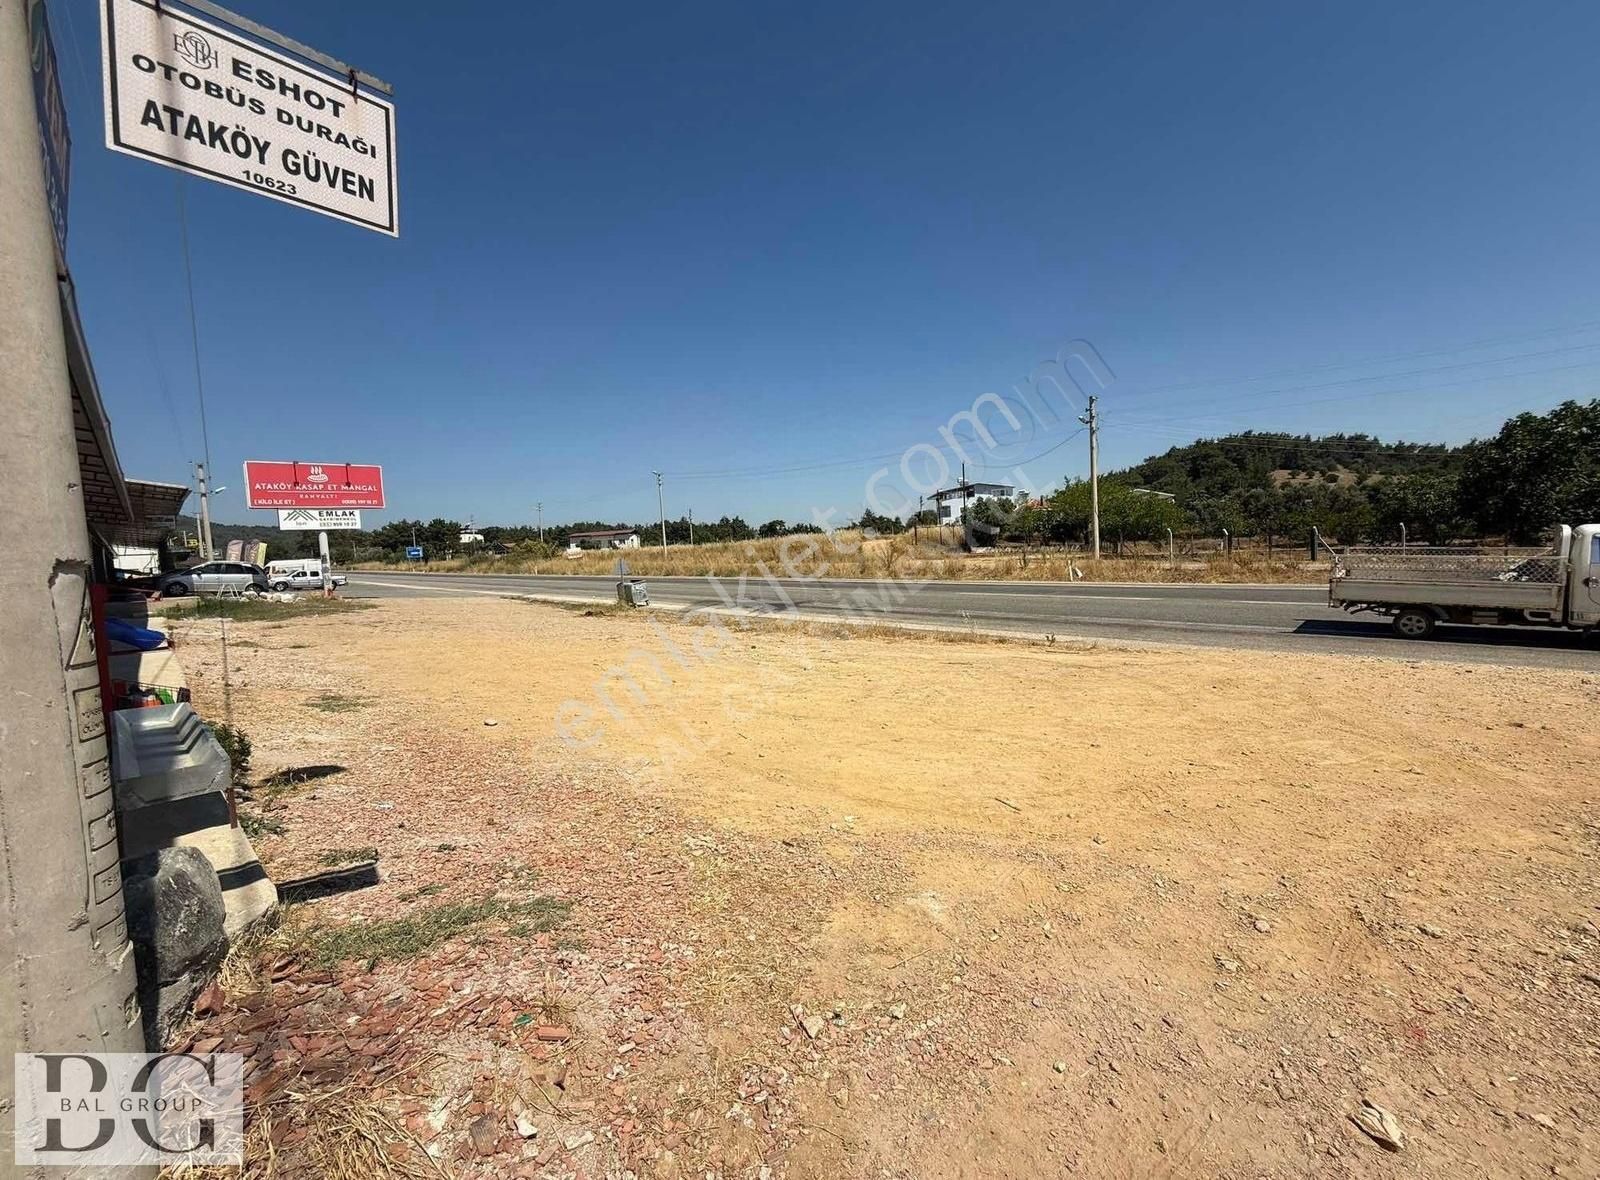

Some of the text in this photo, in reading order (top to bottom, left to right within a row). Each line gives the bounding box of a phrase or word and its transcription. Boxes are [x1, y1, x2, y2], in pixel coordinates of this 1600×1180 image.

[132, 53, 377, 159] OTOBÜS DURAĞI
[232, 57, 345, 118] ESHOT
[140, 99, 375, 202] ATAKÖY GÜVEN
[242, 170, 297, 195] 10623
[255, 482, 292, 490] ATAKÖY
